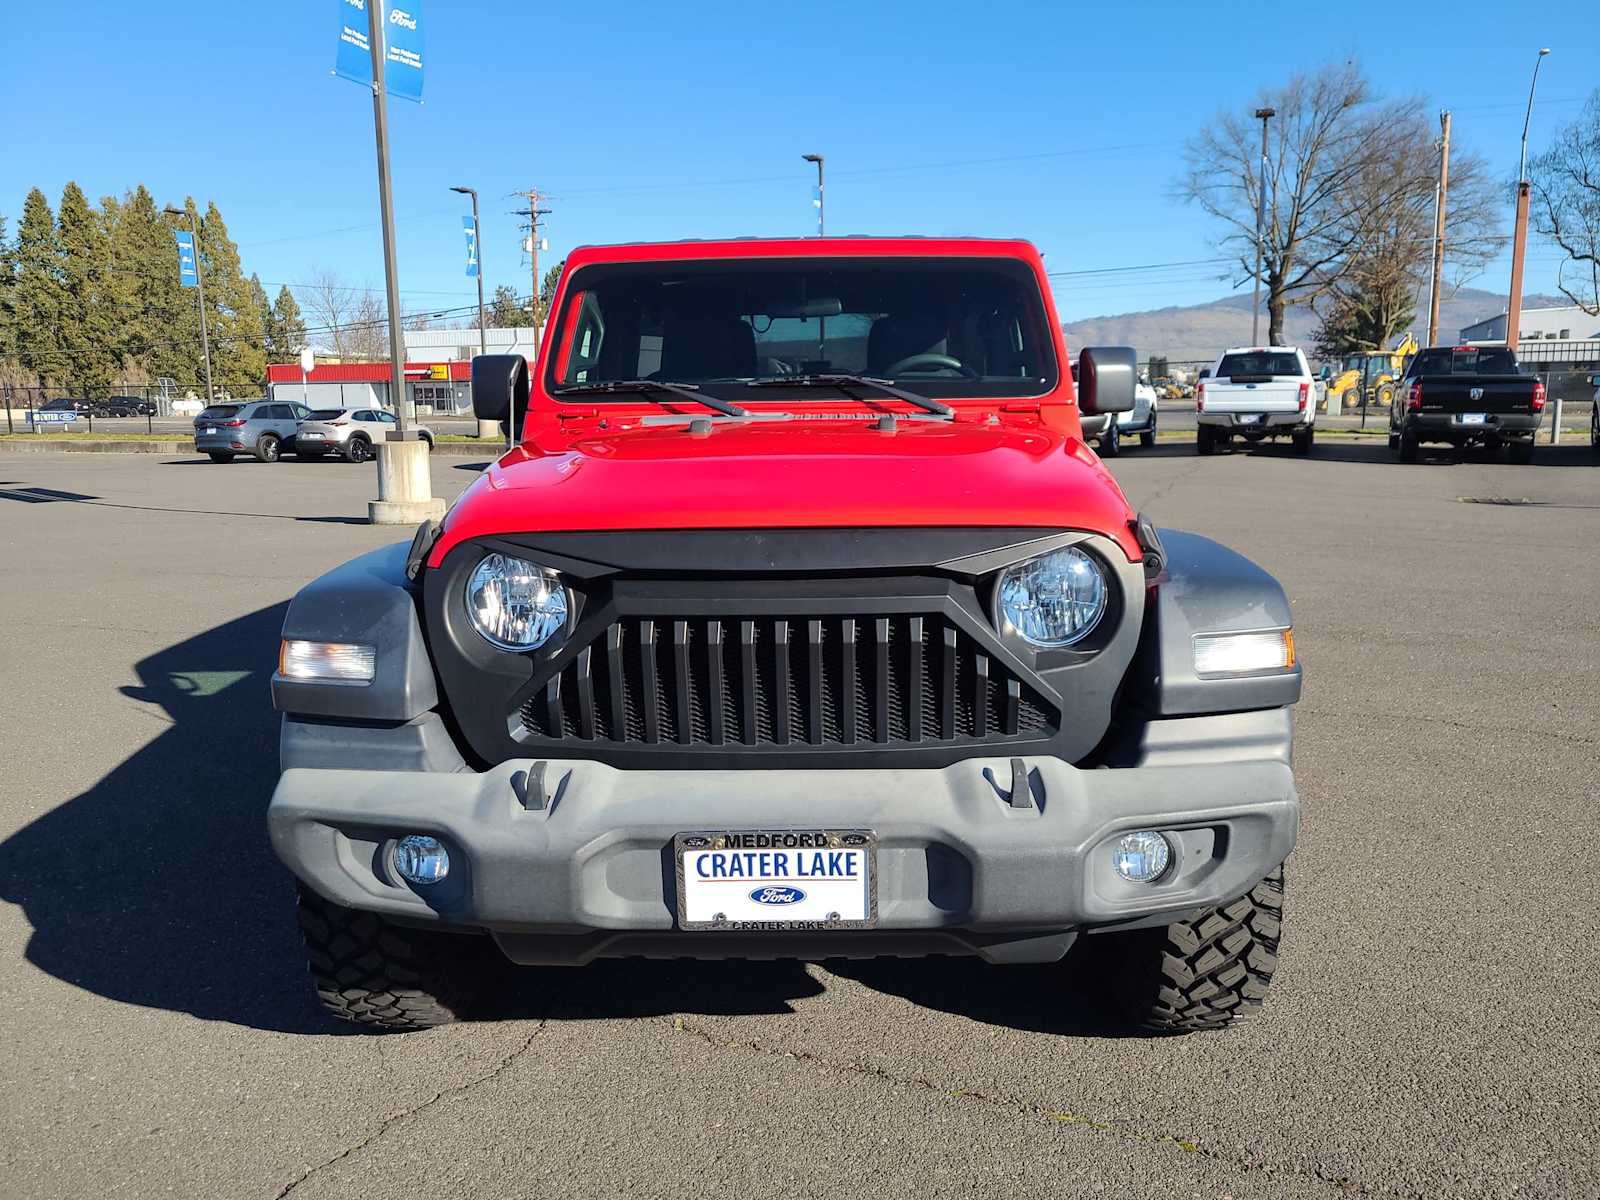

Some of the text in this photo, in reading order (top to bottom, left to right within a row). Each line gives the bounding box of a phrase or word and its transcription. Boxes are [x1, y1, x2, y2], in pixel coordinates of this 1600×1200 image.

[389, 8, 417, 30] Ford
[724, 833, 828, 848] MEDFORD
[696, 852, 858, 878] CRATER LAKE
[760, 888, 796, 903] Ford
[732, 921, 785, 930] CRATER
[790, 920, 825, 930] LAKE
